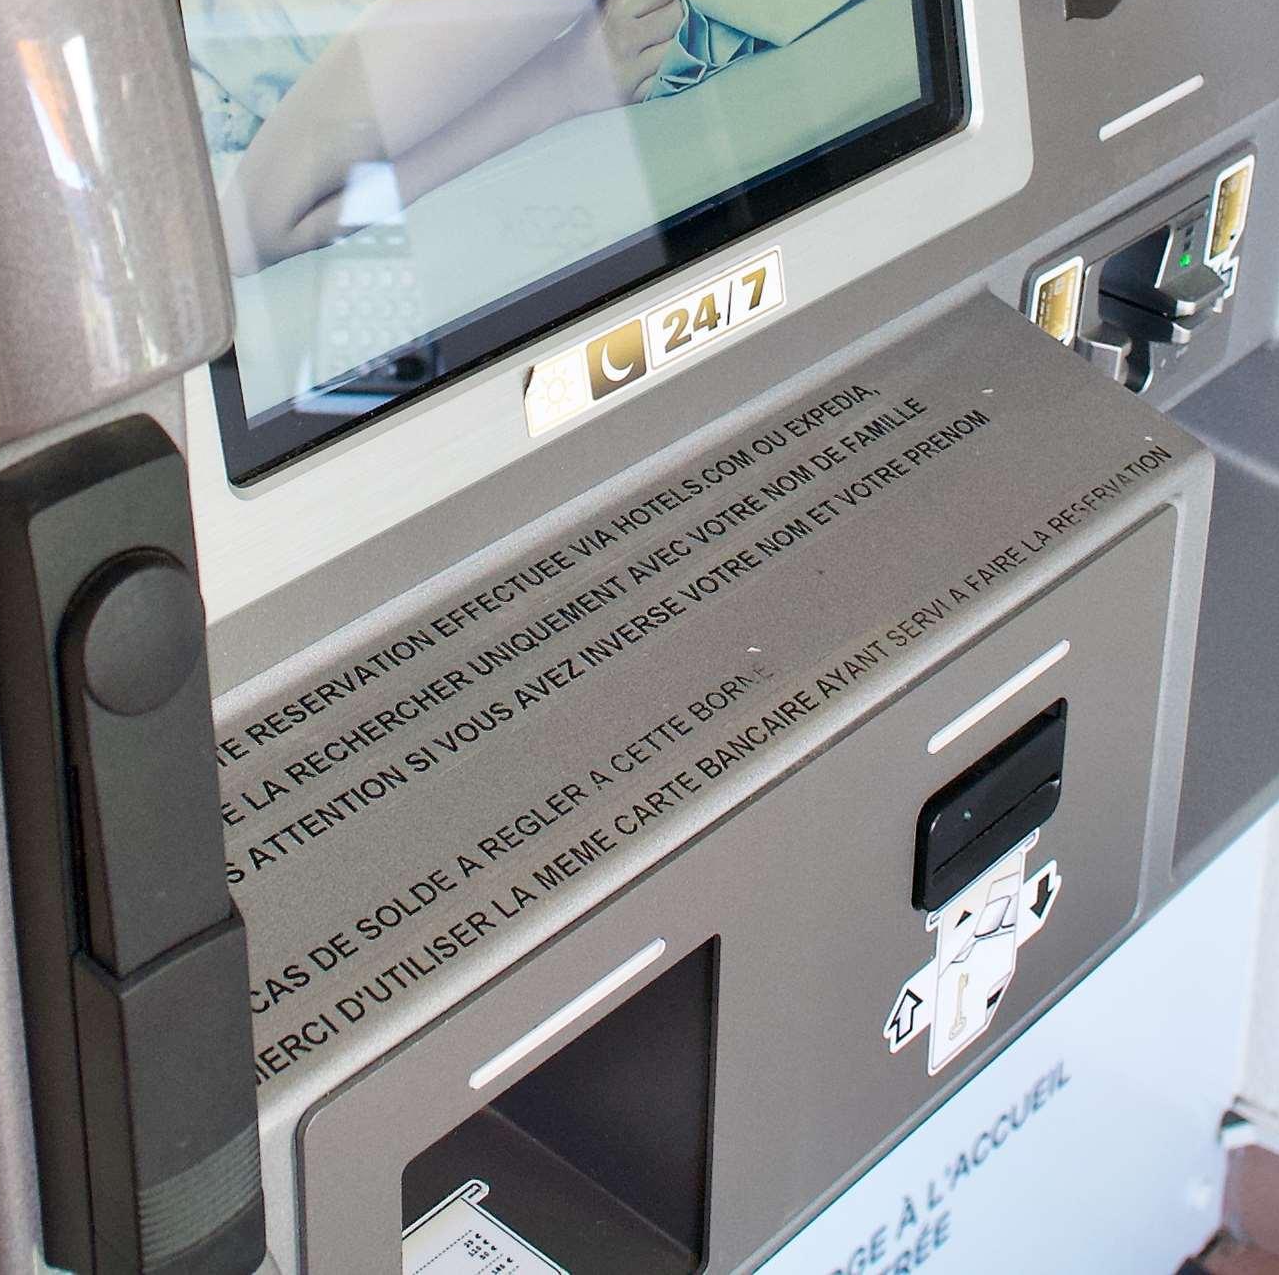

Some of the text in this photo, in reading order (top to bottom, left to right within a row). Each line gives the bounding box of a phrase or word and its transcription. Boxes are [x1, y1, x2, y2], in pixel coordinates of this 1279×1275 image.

[662, 266, 768, 355] 24/7
[242, 778, 290, 812] LA
[284, 670, 474, 786] RECHERCHER
[466, 575, 629, 677] UNIQUEMENT
[628, 540, 693, 585] AVEC
[688, 492, 769, 546] VOTRE
[761, 463, 825, 510] NOM
[816, 448, 845, 473] DE
[841, 395, 928, 459] FAMILLE
[245, 629, 436, 746] RESERVATION
[430, 551, 575, 639] EFFECTUEE
[569, 528, 618, 562] VIA
[611, 448, 752, 536] HOTELS.COM
[752, 431, 787, 458] OU
[784, 384, 880, 439] EXPEDIA,
[248, 764, 409, 872] ATTENTION
[404, 746, 440, 775] SI
[433, 701, 515, 755] VOUS
[513, 657, 587, 711] AVEZ
[578, 594, 687, 669] INVERSE
[681, 541, 762, 603] VOTRE
[754, 518, 816, 561] NOM
[812, 499, 843, 528] ET
[832, 461, 911, 511] VOTRE
[904, 408, 991, 470] PRENOM
[335, 910, 497, 1024] D'UTILISER
[493, 885, 537, 917] LA
[533, 835, 618, 892] MEME
[612, 770, 701, 836] CARTE
[695, 690, 821, 780] BANCAIRE
[815, 640, 889, 699] AYANT
[886, 598, 952, 648] SERVI
[947, 585, 970, 605] A
[964, 548, 1025, 593] FAIRE
[1021, 529, 1052, 552] LA
[1047, 445, 1173, 534] RESERVATION
[308, 935, 360, 972] DE
[355, 868, 457, 942] SOLDE
[458, 853, 486, 878] A
[477, 783, 586, 863] REGLER
[588, 768, 613, 792] A
[610, 713, 694, 774] CETTE
